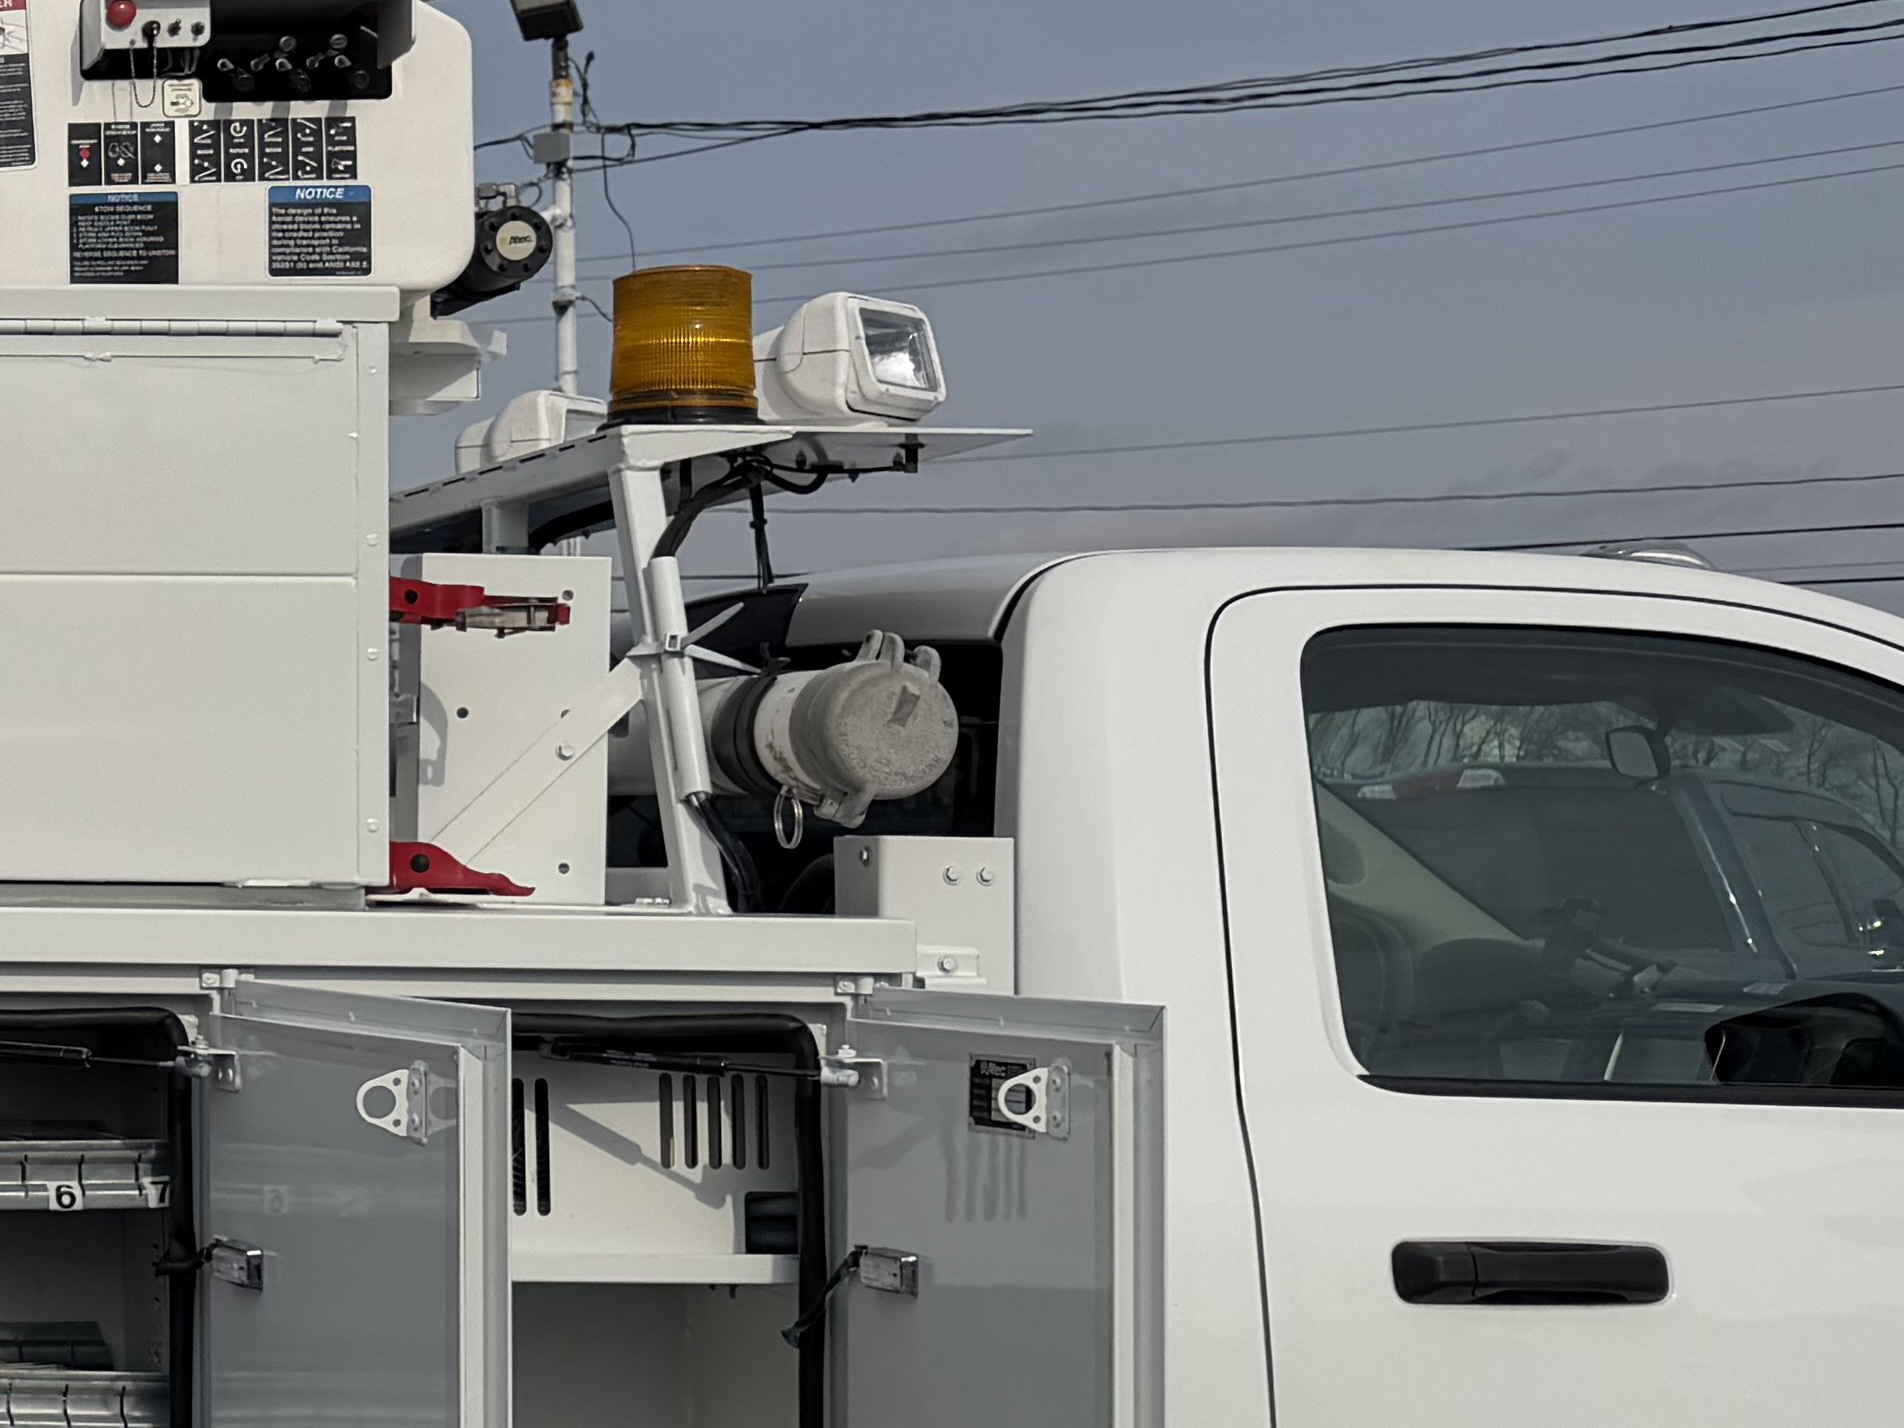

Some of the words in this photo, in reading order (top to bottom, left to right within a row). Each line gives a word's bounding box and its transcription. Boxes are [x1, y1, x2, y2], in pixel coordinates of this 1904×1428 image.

[107, 194, 139, 203] NOTICE
[295, 187, 345, 200] NOTICE
[55, 1184, 77, 1209] 6
[150, 1180, 171, 1204] 7
